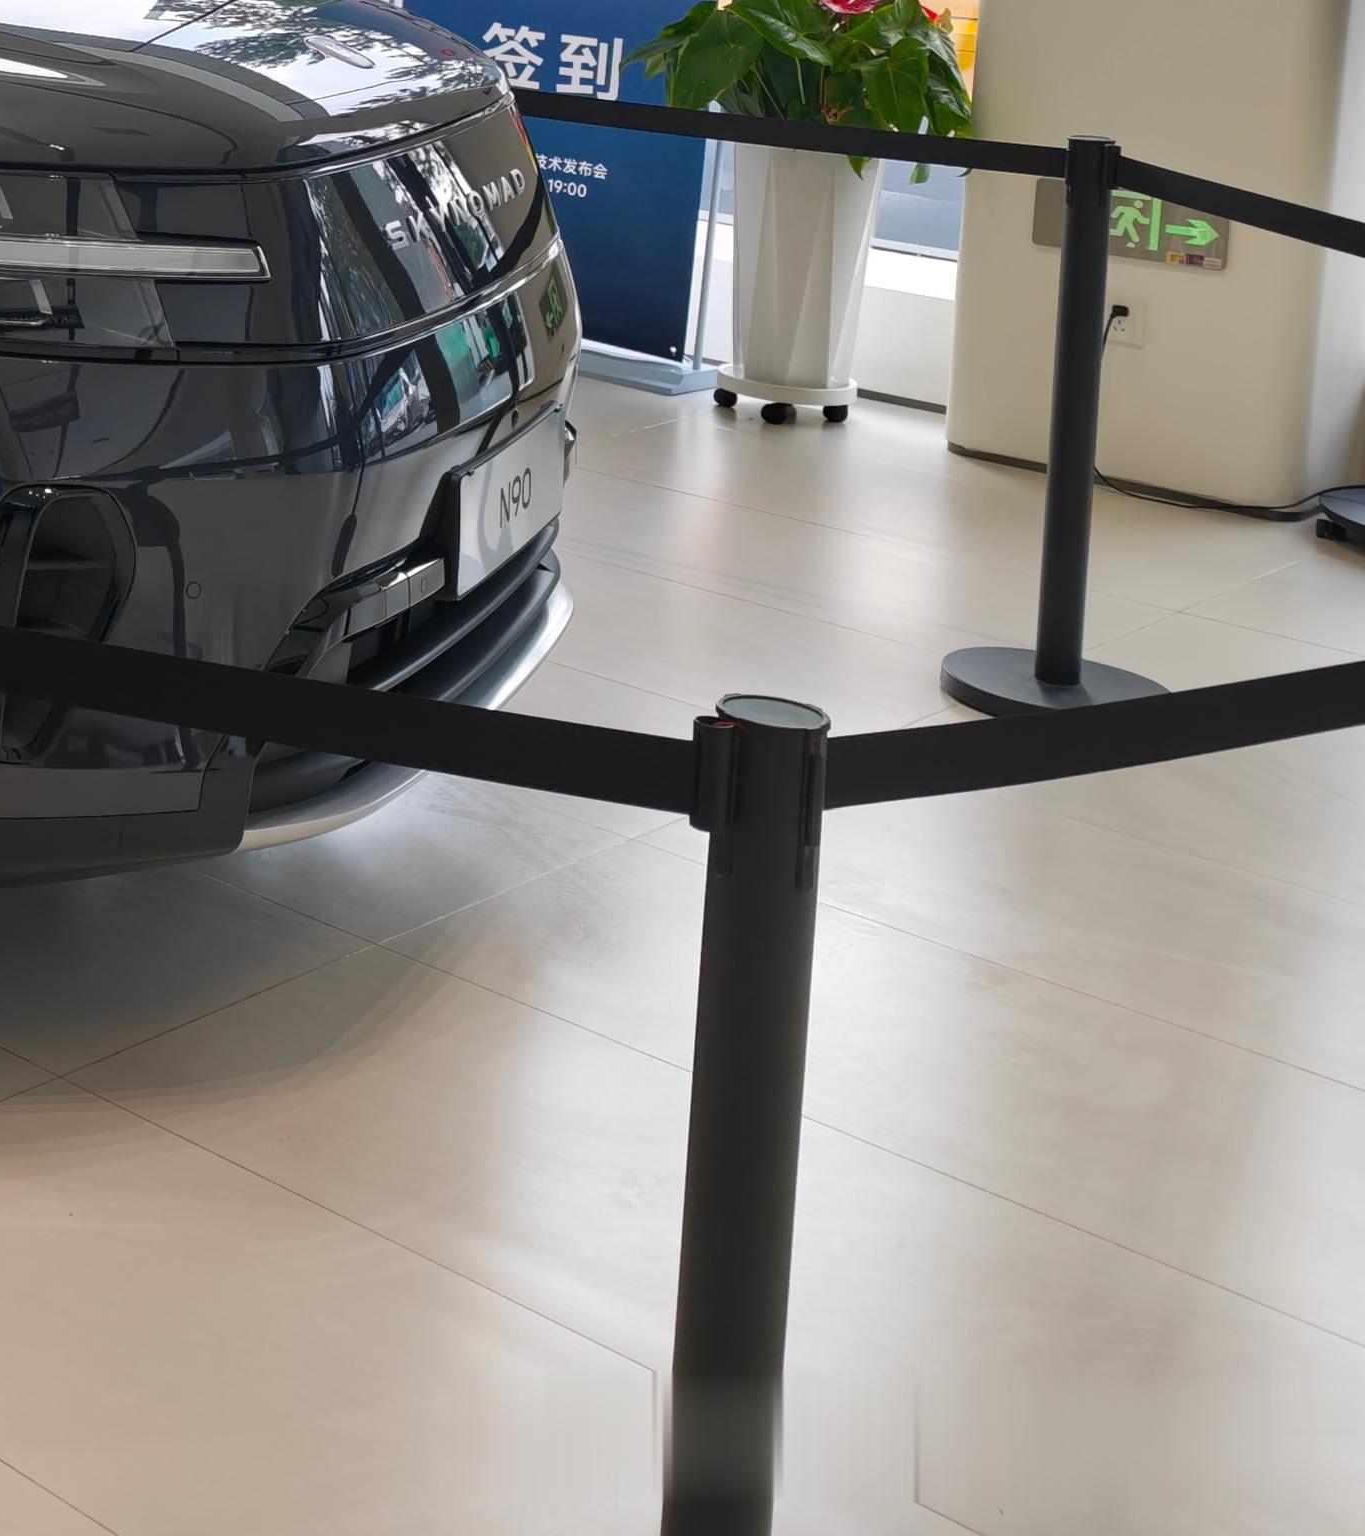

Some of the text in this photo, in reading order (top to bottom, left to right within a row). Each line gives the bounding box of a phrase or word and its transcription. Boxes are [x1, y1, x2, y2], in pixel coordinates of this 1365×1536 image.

[481, 22, 623, 101] 签到
[384, 168, 526, 251] SKYNOMAD
[547, 178, 588, 199] 19:00
[499, 467, 532, 529] N90
